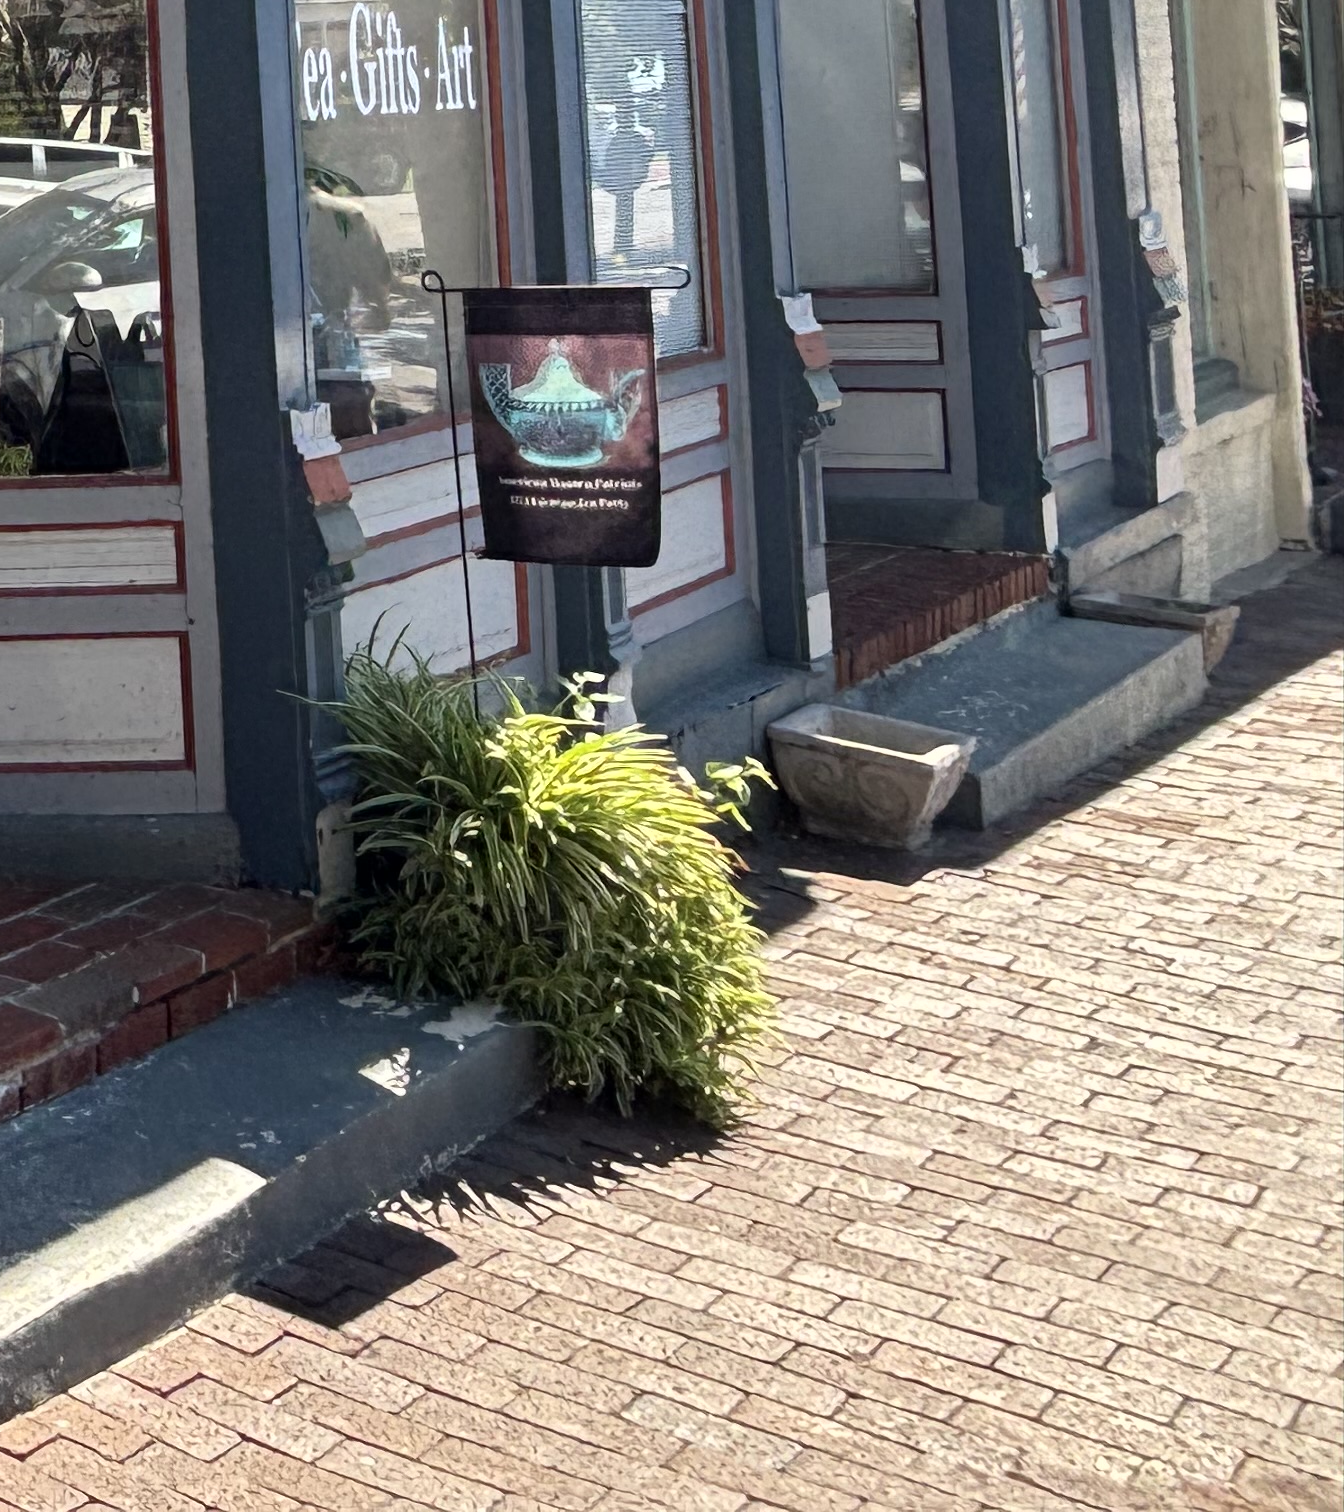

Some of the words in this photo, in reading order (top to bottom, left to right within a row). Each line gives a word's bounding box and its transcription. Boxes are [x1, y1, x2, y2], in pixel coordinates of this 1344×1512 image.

[296, 21, 337, 122] ea
[349, 2, 421, 116] Gifts
[435, 16, 477, 111] Art
